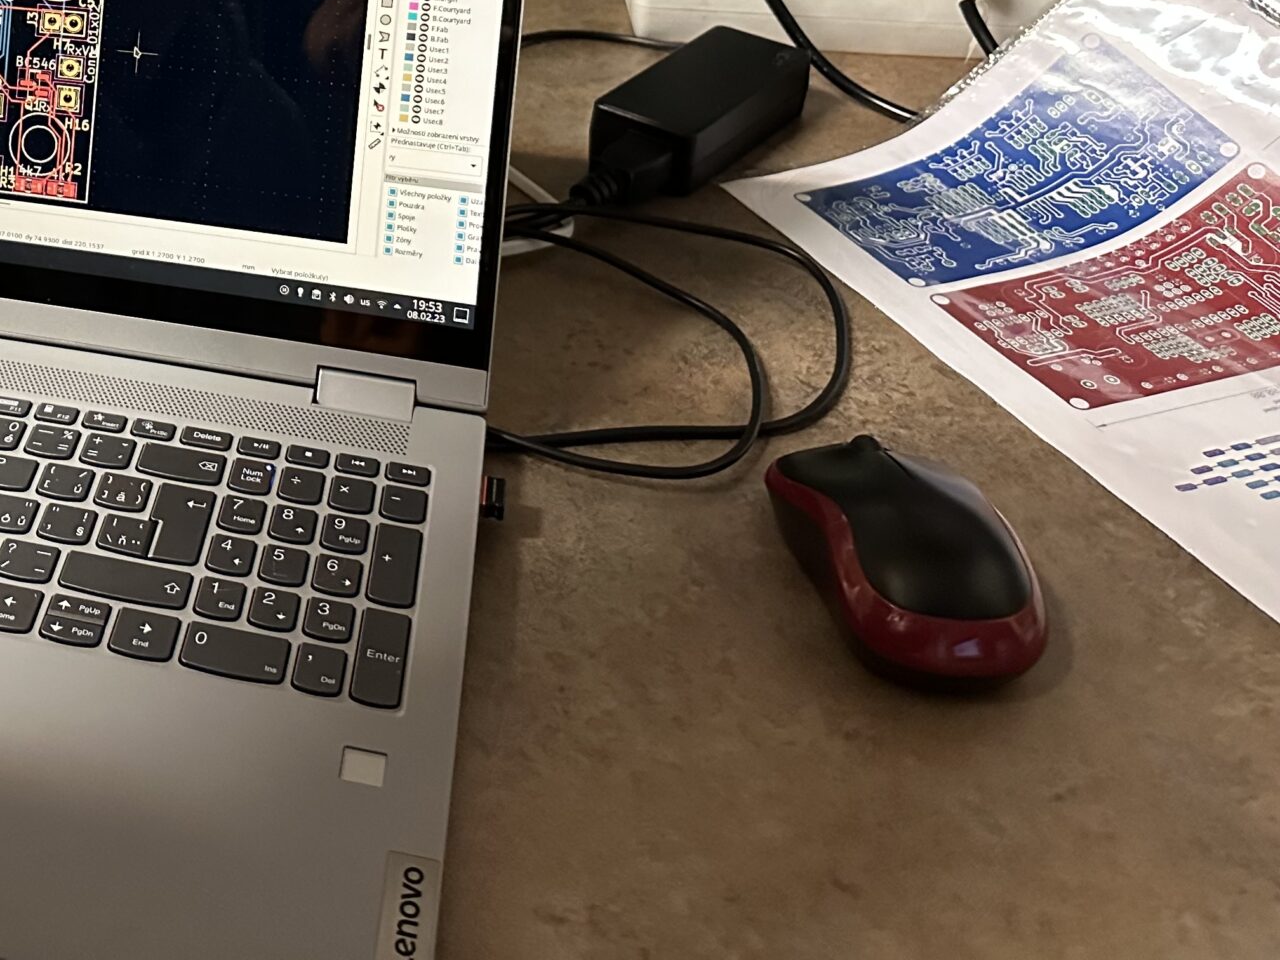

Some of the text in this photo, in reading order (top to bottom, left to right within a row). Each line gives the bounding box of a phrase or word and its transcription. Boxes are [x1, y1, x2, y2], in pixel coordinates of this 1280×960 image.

[433, 5, 471, 15] F.Courtyard
[26, 12, 38, 25] J3
[432, 16, 471, 25] B.Courtyard
[16, 55, 56, 71] BC546
[64, 118, 90, 131] H16
[400, 190, 452, 203] Všechny položky
[399, 201, 425, 210] Pouzdra
[412, 299, 443, 313] 19:53
[407, 310, 446, 324] 08.02.23
[193, 431, 222, 442] Delete
[240, 473, 262, 484] Lock
[242, 467, 264, 478] Num
[232, 498, 245, 510] 7
[233, 514, 257, 525] Home
[282, 508, 295, 521] 8
[334, 518, 347, 531] 9
[221, 539, 233, 552] 4
[338, 534, 361, 545] PgUp
[272, 548, 286, 562] 5
[326, 559, 339, 572] 6
[211, 581, 220, 595] 1
[261, 592, 276, 605] 2
[79, 603, 102, 616] PgUp
[218, 600, 235, 611] End
[317, 602, 331, 616] 3
[71, 626, 94, 639] PgDn
[322, 620, 346, 632] PgDn
[132, 638, 149, 649] End
[194, 631, 208, 645] 0
[366, 648, 401, 664] Enter
[264, 663, 277, 674] Ins
[320, 675, 336, 685] Del
[394, 866, 424, 960] enovo
